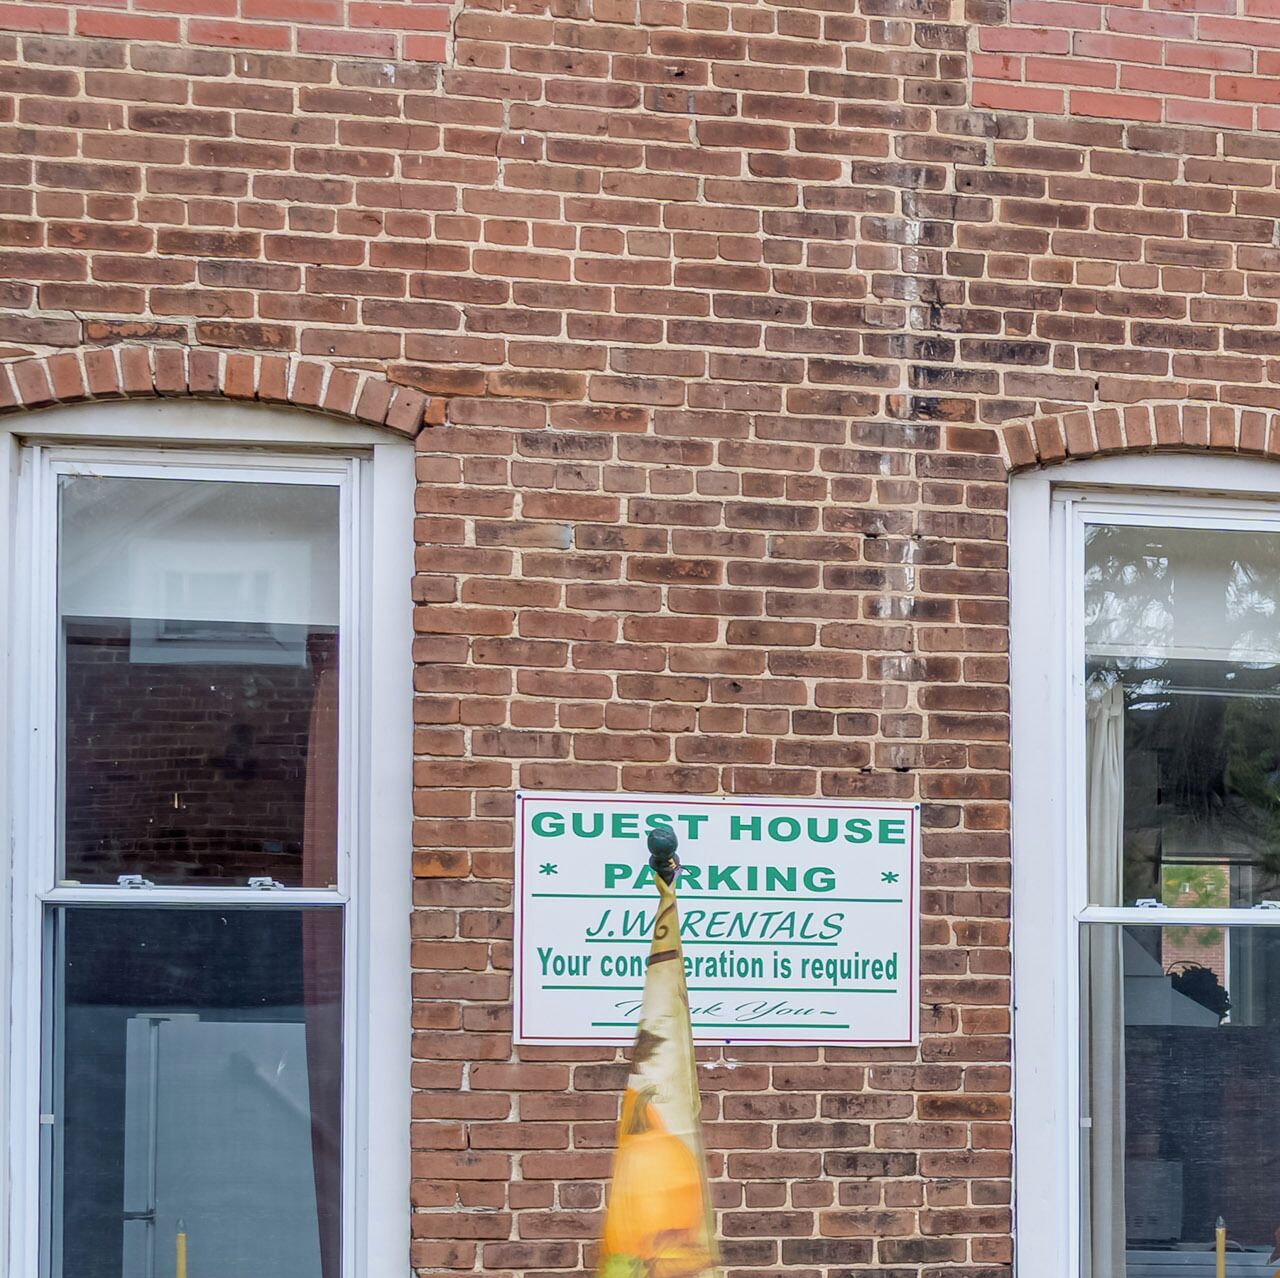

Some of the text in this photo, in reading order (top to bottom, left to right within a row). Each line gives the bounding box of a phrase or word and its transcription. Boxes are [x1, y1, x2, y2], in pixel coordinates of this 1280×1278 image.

[531, 811, 906, 844] GUEST HOUSE
[680, 910, 845, 939] RENTALS
[537, 947, 591, 976] Your
[773, 950, 792, 979] is
[801, 952, 897, 986] required
